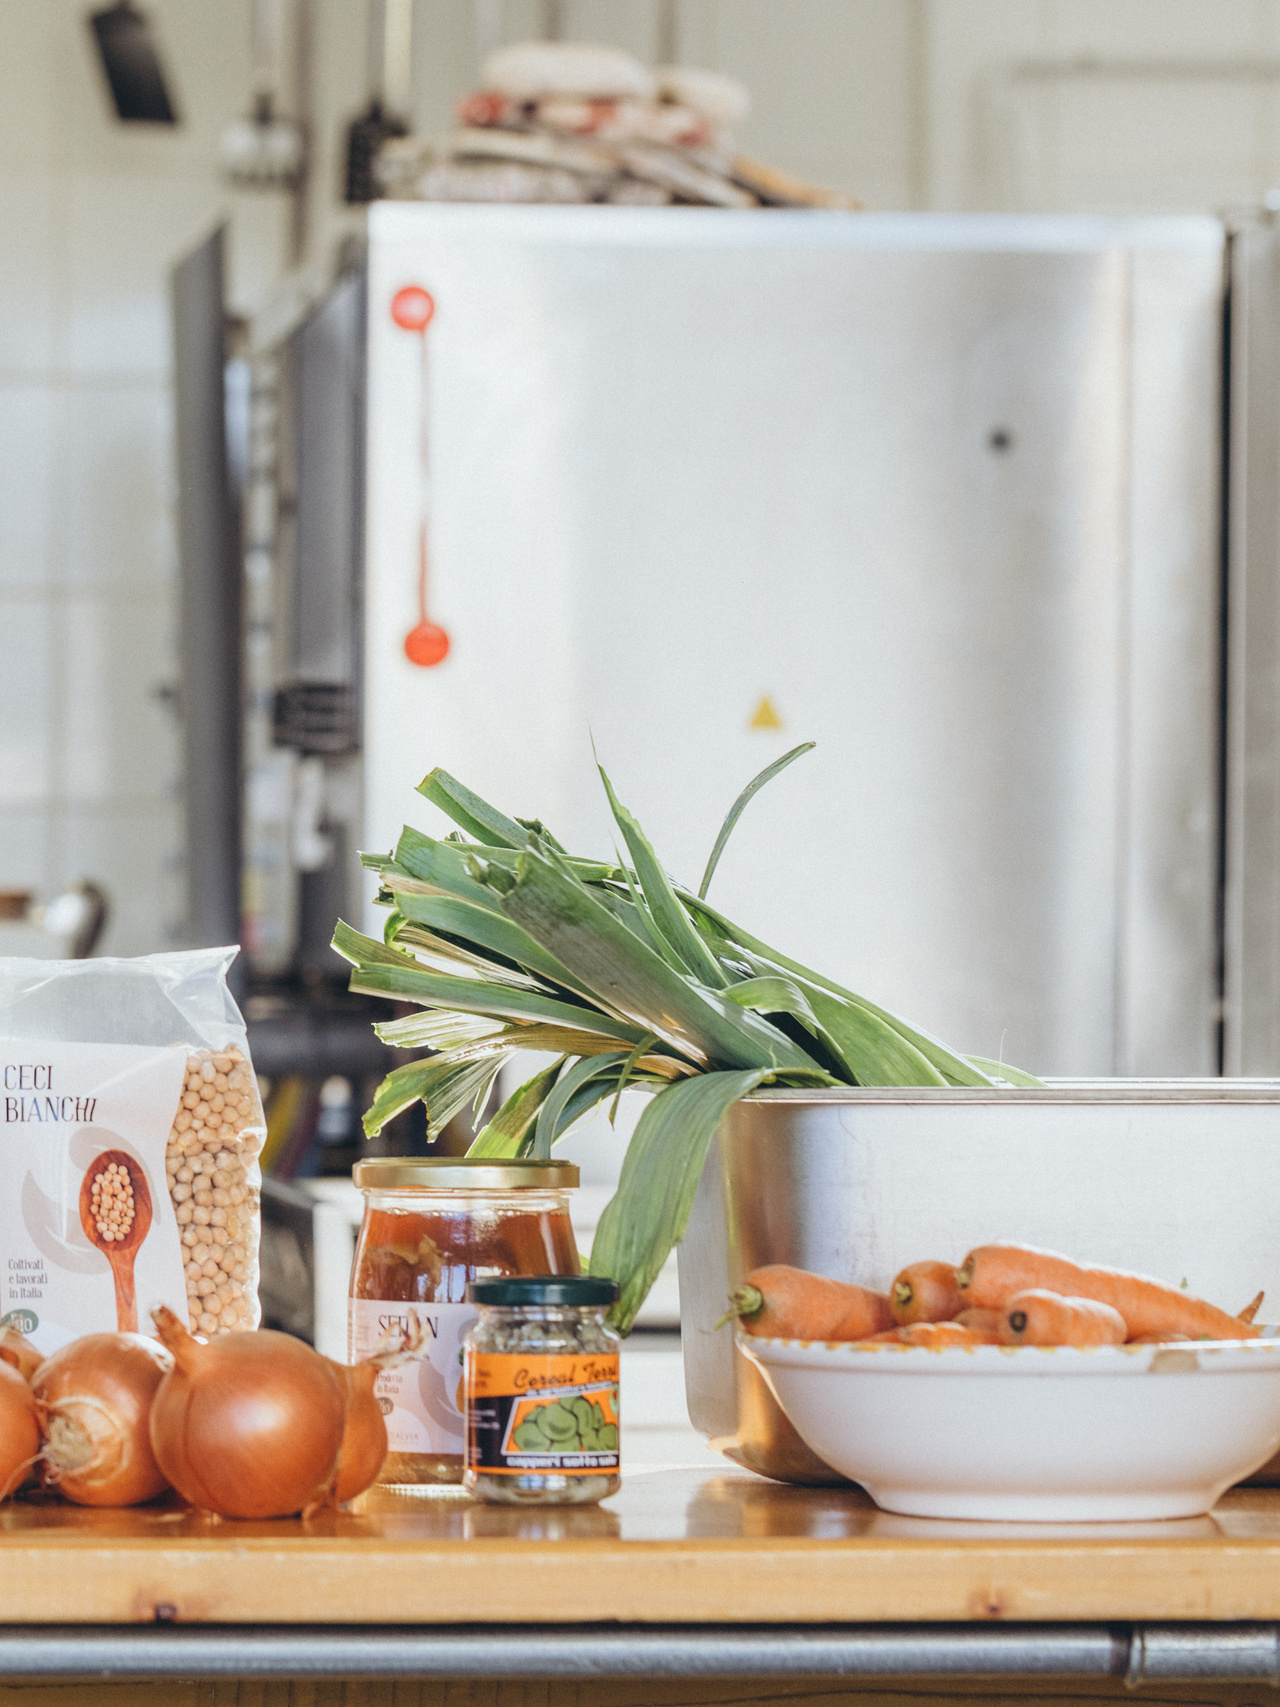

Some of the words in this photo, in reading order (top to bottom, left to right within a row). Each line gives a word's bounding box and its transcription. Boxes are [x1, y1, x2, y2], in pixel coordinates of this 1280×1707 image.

[4, 1064, 53, 1090] CECI
[4, 1096, 98, 1123] BIANCHI
[8, 1259, 44, 1270] Coltivati
[9, 1275, 15, 1284] e
[16, 1273, 48, 1284] lavorati
[9, 1287, 18, 1298] in
[20, 1287, 43, 1298] Italia
